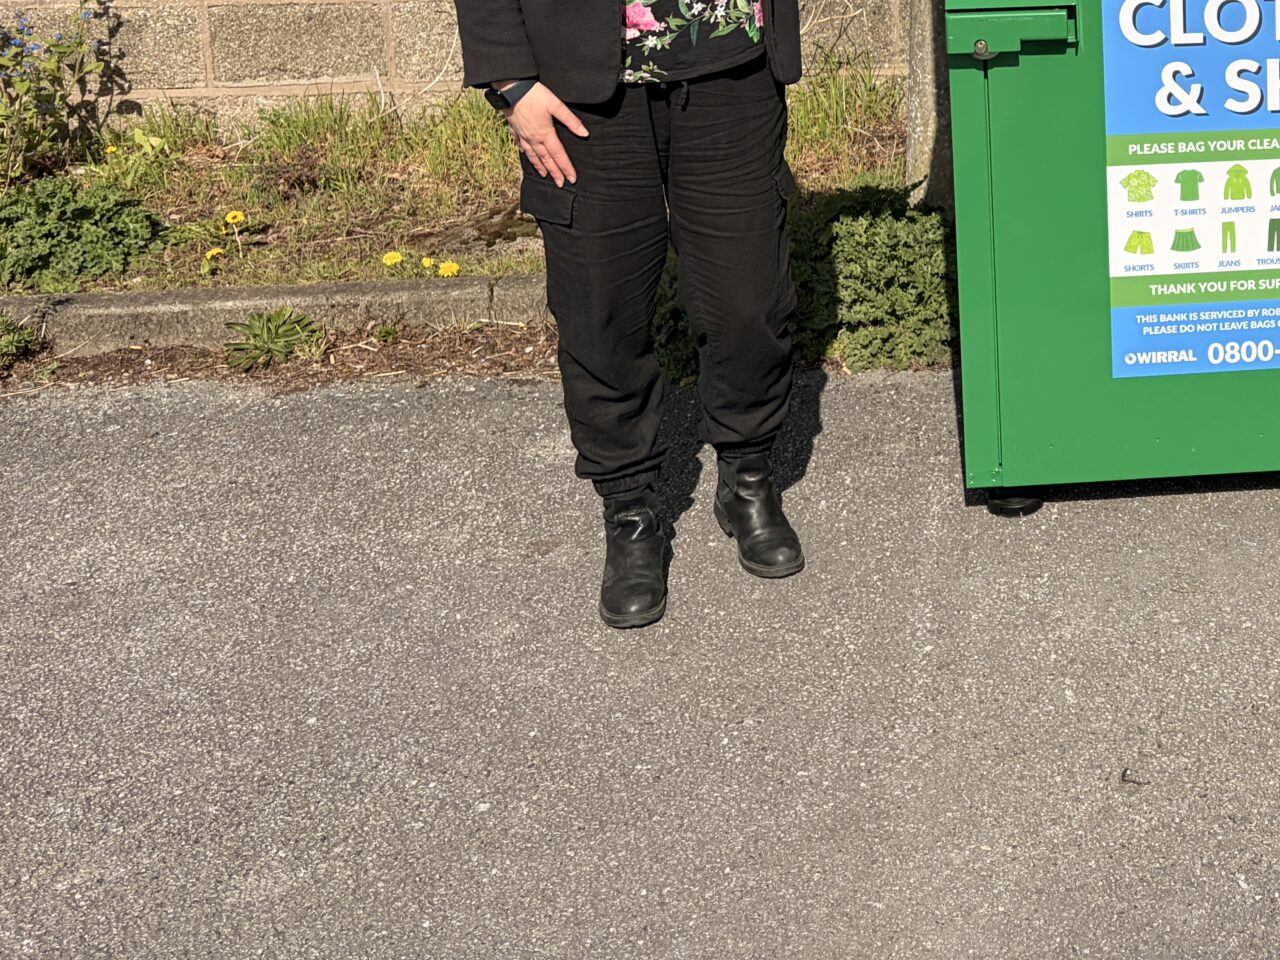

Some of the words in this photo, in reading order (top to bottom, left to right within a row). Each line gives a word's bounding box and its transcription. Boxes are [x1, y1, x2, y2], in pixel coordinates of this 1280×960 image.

[1154, 61, 1209, 118] &
[1128, 142, 1175, 155] PLEASE
[1178, 141, 1205, 153] BAG
[1208, 140, 1245, 152] YOUR
[1126, 210, 1153, 218] SHIRTS
[1174, 208, 1207, 217] T-SHIRTS
[1220, 206, 1256, 215] JUMPERS
[1124, 264, 1155, 273] SHORTS
[1173, 261, 1200, 270] SKIRTS
[1217, 259, 1241, 268] JEANS
[1149, 282, 1196, 296] THANK
[1199, 281, 1227, 293] YOU
[1230, 279, 1257, 291] FOR
[1135, 314, 1158, 324] THIS
[1160, 313, 1187, 323] BANK
[1189, 312, 1198, 321] IS
[1199, 310, 1246, 320] SERVICED
[1247, 309, 1261, 318] BY
[1143, 325, 1178, 335] PLEASE
[1179, 324, 1195, 333] DO
[1197, 323, 1218, 332] NOT
[1219, 321, 1249, 331] LEAVE
[1250, 320, 1276, 329] BAGS
[1136, 349, 1197, 365] WIRRAL
